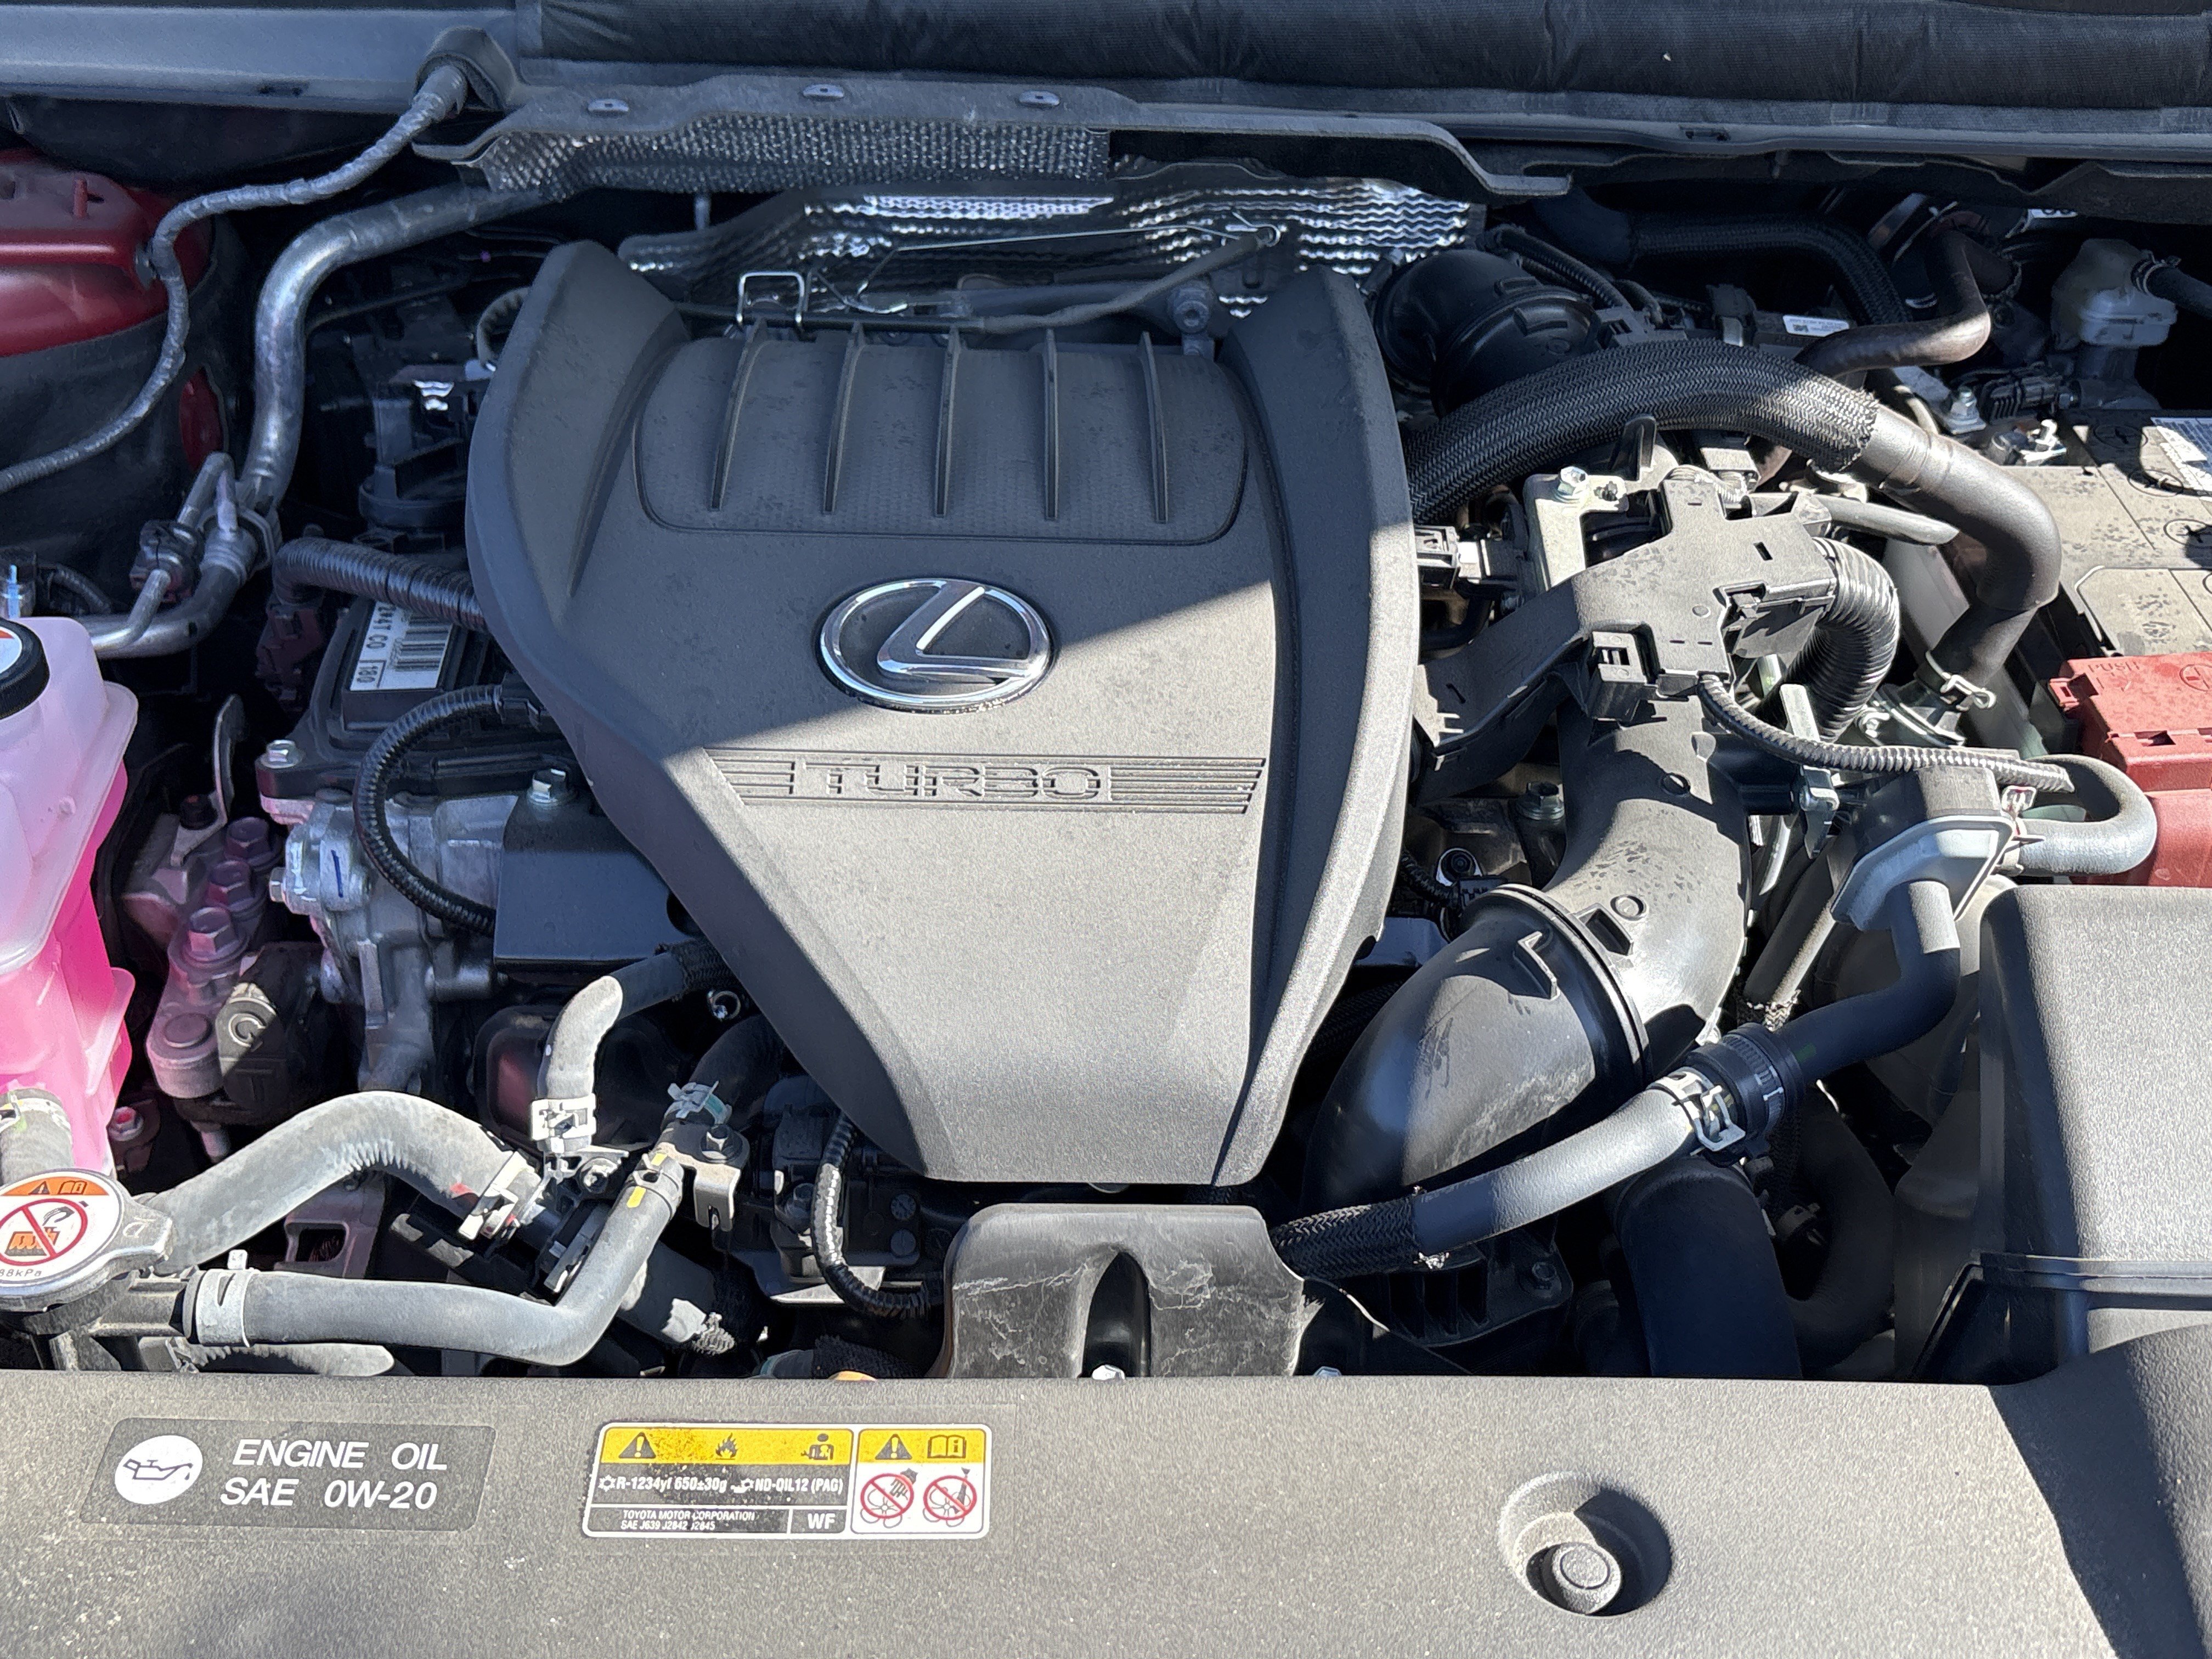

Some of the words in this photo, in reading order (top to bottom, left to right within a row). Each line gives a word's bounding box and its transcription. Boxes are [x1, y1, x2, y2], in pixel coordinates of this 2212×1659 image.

[802, 762, 1101, 799] TURBO
[233, 1438, 369, 1469] ENGINE
[391, 1442, 448, 1471] OIL
[220, 1477, 300, 1507] SAE
[324, 1480, 438, 1510] 0W-20
[811, 1478, 844, 1495] (PAG)
[623, 1510, 657, 1520] TOYOTA
[658, 1510, 691, 1520] MOTOR
[692, 1511, 755, 1521] CORPORATION
[808, 1513, 836, 1530] WF
[620, 1520, 638, 1530] SAE
[639, 1520, 661, 1530] J639
